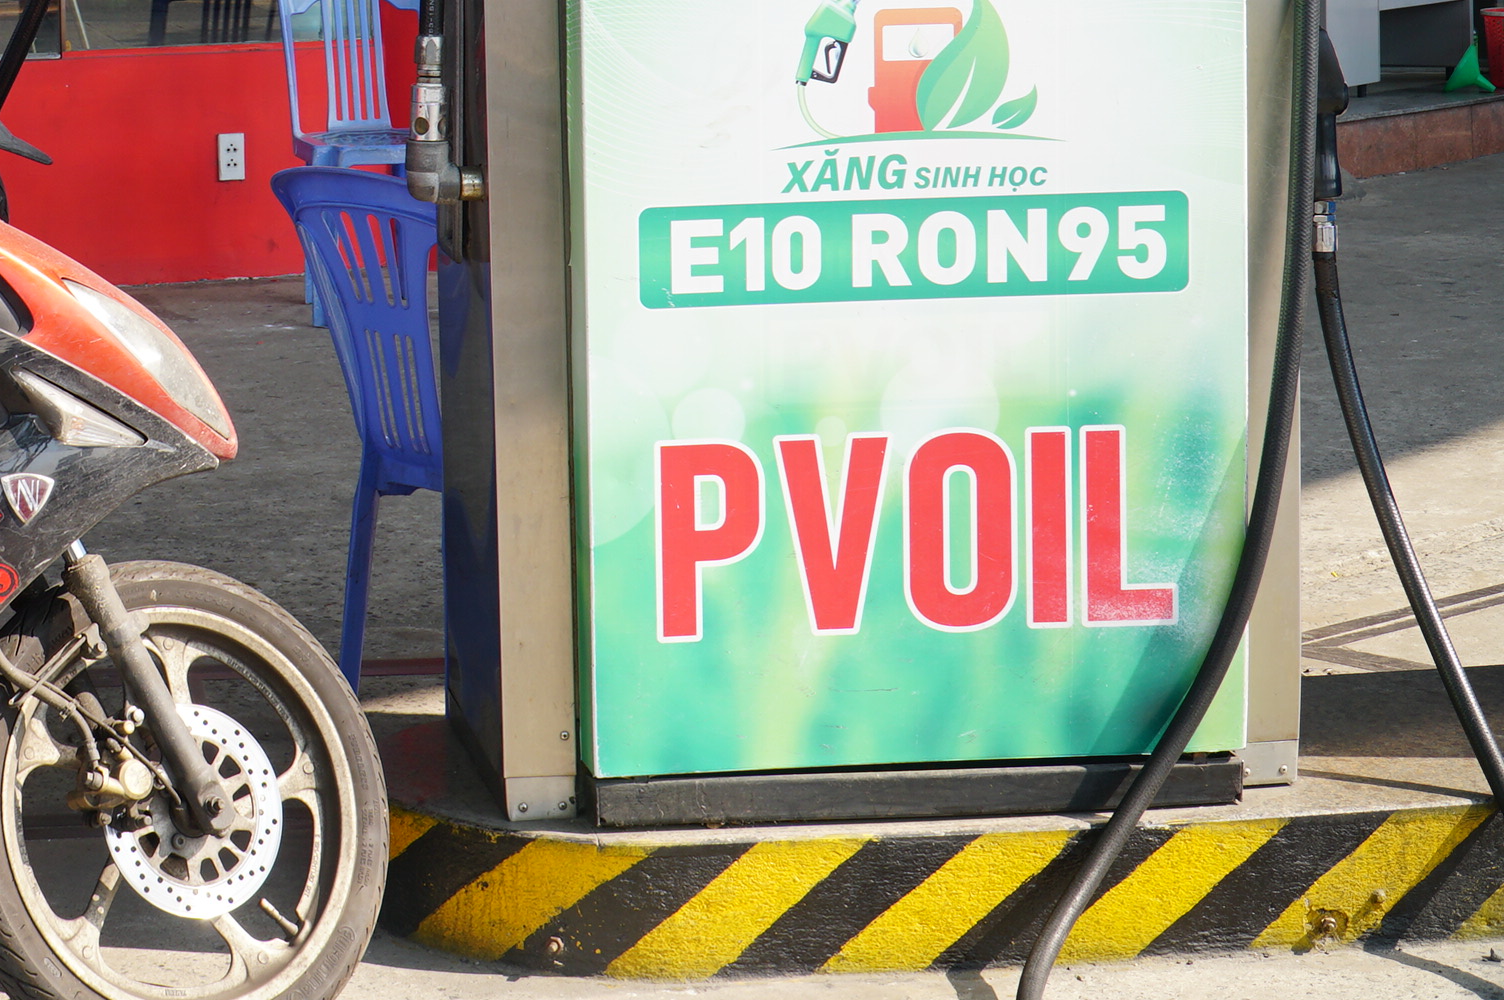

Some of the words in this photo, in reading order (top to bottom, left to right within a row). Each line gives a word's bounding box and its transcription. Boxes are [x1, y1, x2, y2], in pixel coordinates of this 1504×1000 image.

[781, 149, 907, 195] XĂNG
[913, 165, 980, 190] SINH
[988, 165, 1048, 192] HỌC
[669, 215, 822, 295] E10
[653, 424, 1179, 644] PVOIL
